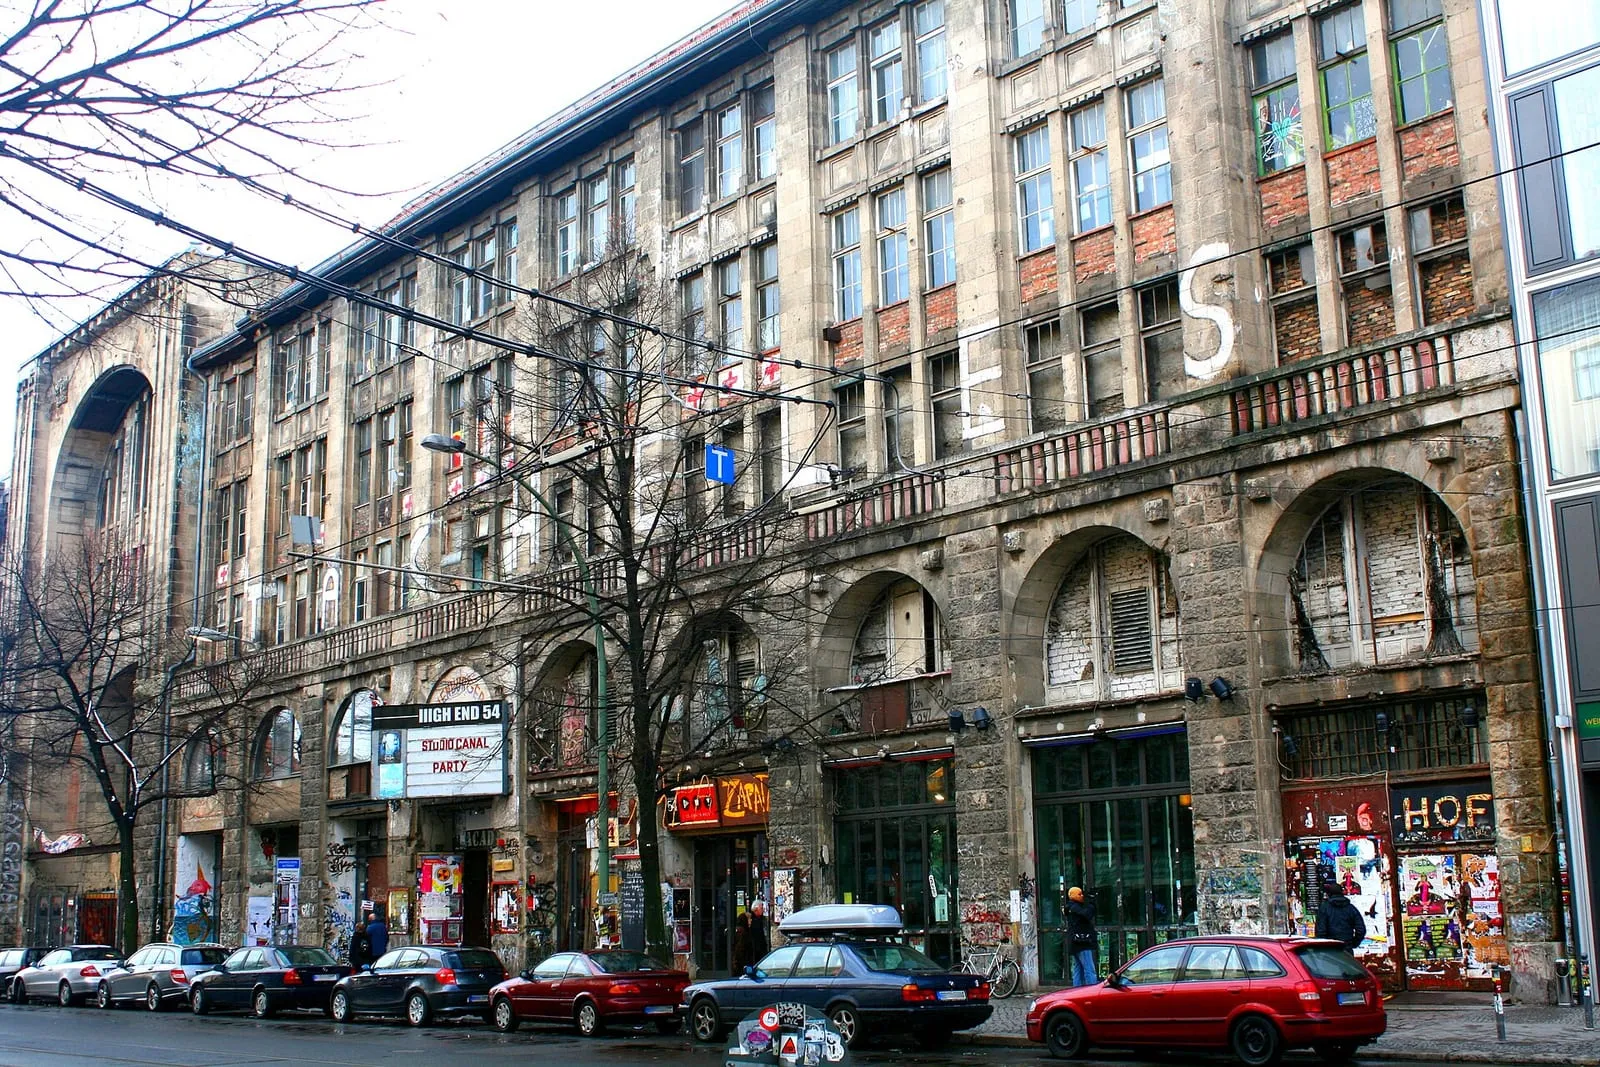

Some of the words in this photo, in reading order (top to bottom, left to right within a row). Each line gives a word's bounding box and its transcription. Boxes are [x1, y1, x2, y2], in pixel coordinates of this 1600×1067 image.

[711, 449, 729, 479] T
[454, 705, 480, 721] END
[482, 703, 501, 720] 54
[455, 737, 489, 750] CANAL
[432, 760, 468, 774] PARTY
[722, 774, 769, 818] ZAPAT
[1403, 793, 1493, 831] HOF
